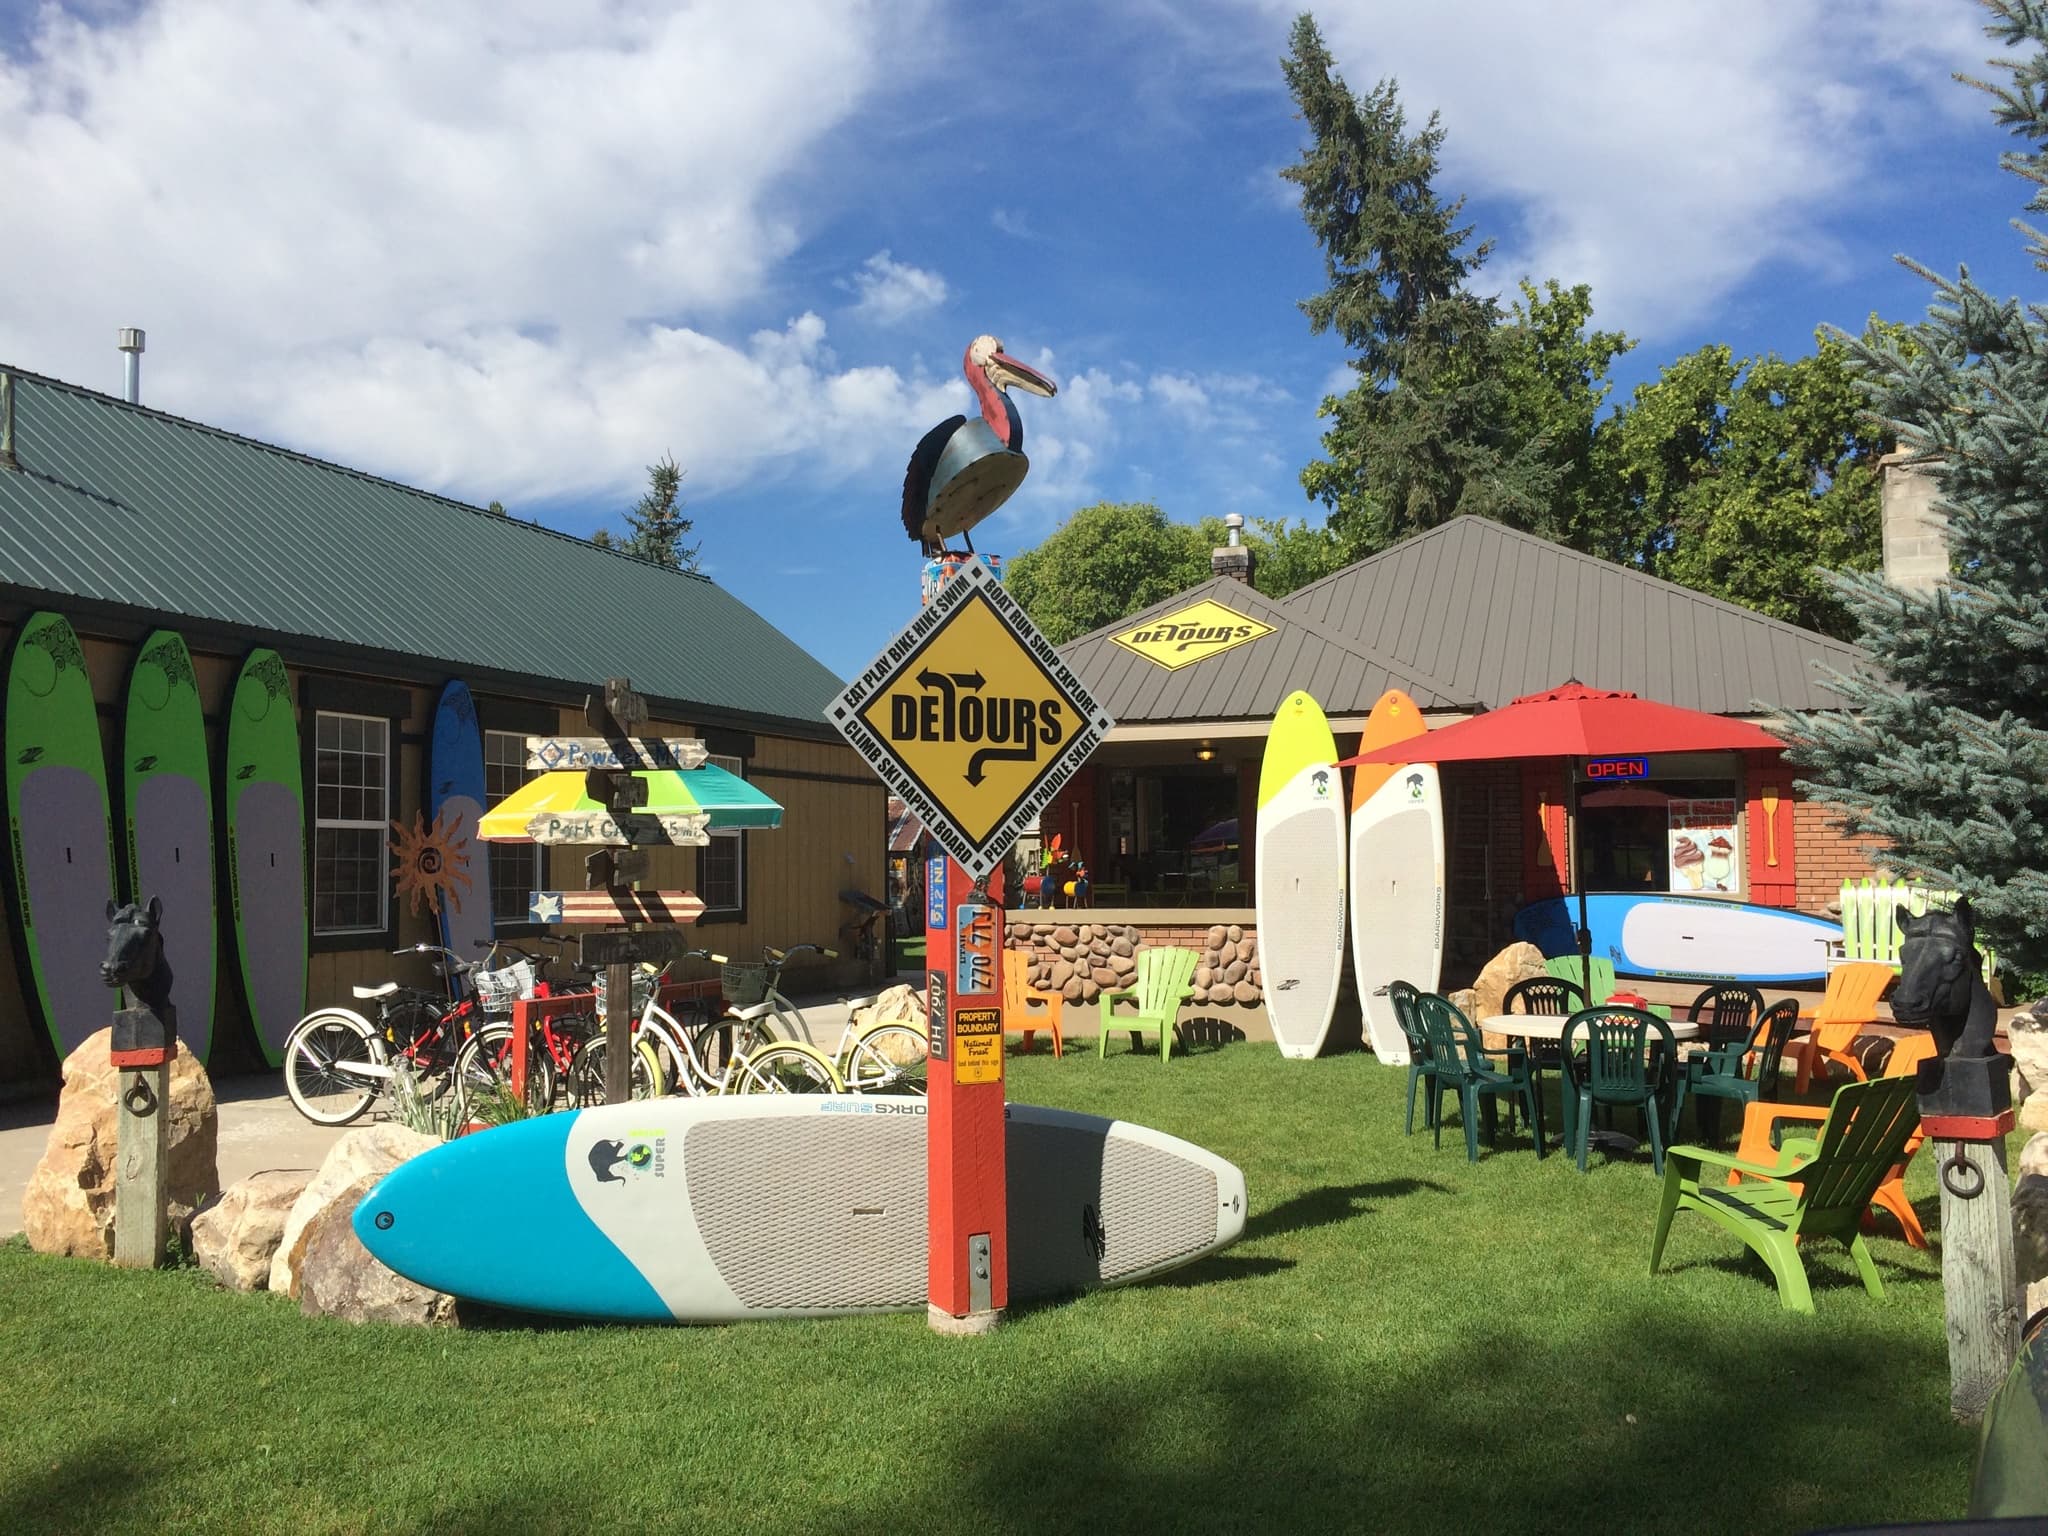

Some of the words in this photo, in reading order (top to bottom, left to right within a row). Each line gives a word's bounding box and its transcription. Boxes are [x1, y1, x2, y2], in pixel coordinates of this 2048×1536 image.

[843, 681, 868, 709] EAT
[862, 655, 893, 689] PLAY
[887, 630, 918, 663] BIKE
[911, 606, 941, 638] HIKE
[936, 574, 971, 612] SWIM
[983, 578, 1014, 613] BOAT
[1009, 609, 1034, 639] RUN
[1030, 634, 1060, 668] SHOP
[1055, 664, 1098, 717] EXPLORE
[1132, 624, 1253, 646] DETOURS
[891, 672, 1062, 748] DETOURS
[568, 744, 645, 766] Powder
[1587, 762, 1643, 777] OPEN
[844, 720, 881, 763] CLIMB
[877, 757, 903, 785] SKI
[895, 778, 938, 827] RAPPEL
[933, 819, 973, 865] BOARD
[983, 825, 1019, 865] PEDAL
[1013, 800, 1040, 831] RUN
[1033, 761, 1073, 807] PADDLE
[1067, 729, 1101, 768] SKATE
[548, 819, 594, 838] Park
[971, 911, 992, 945] 7TJ
[930, 973, 942, 1018] 7907
[957, 1023, 999, 1033] BOUNDARY
[958, 1012, 997, 1022] PROPERTY
[963, 1038, 993, 1049] National
[968, 1048, 989, 1056] Forest
[654, 1137, 666, 1178] SUPER
